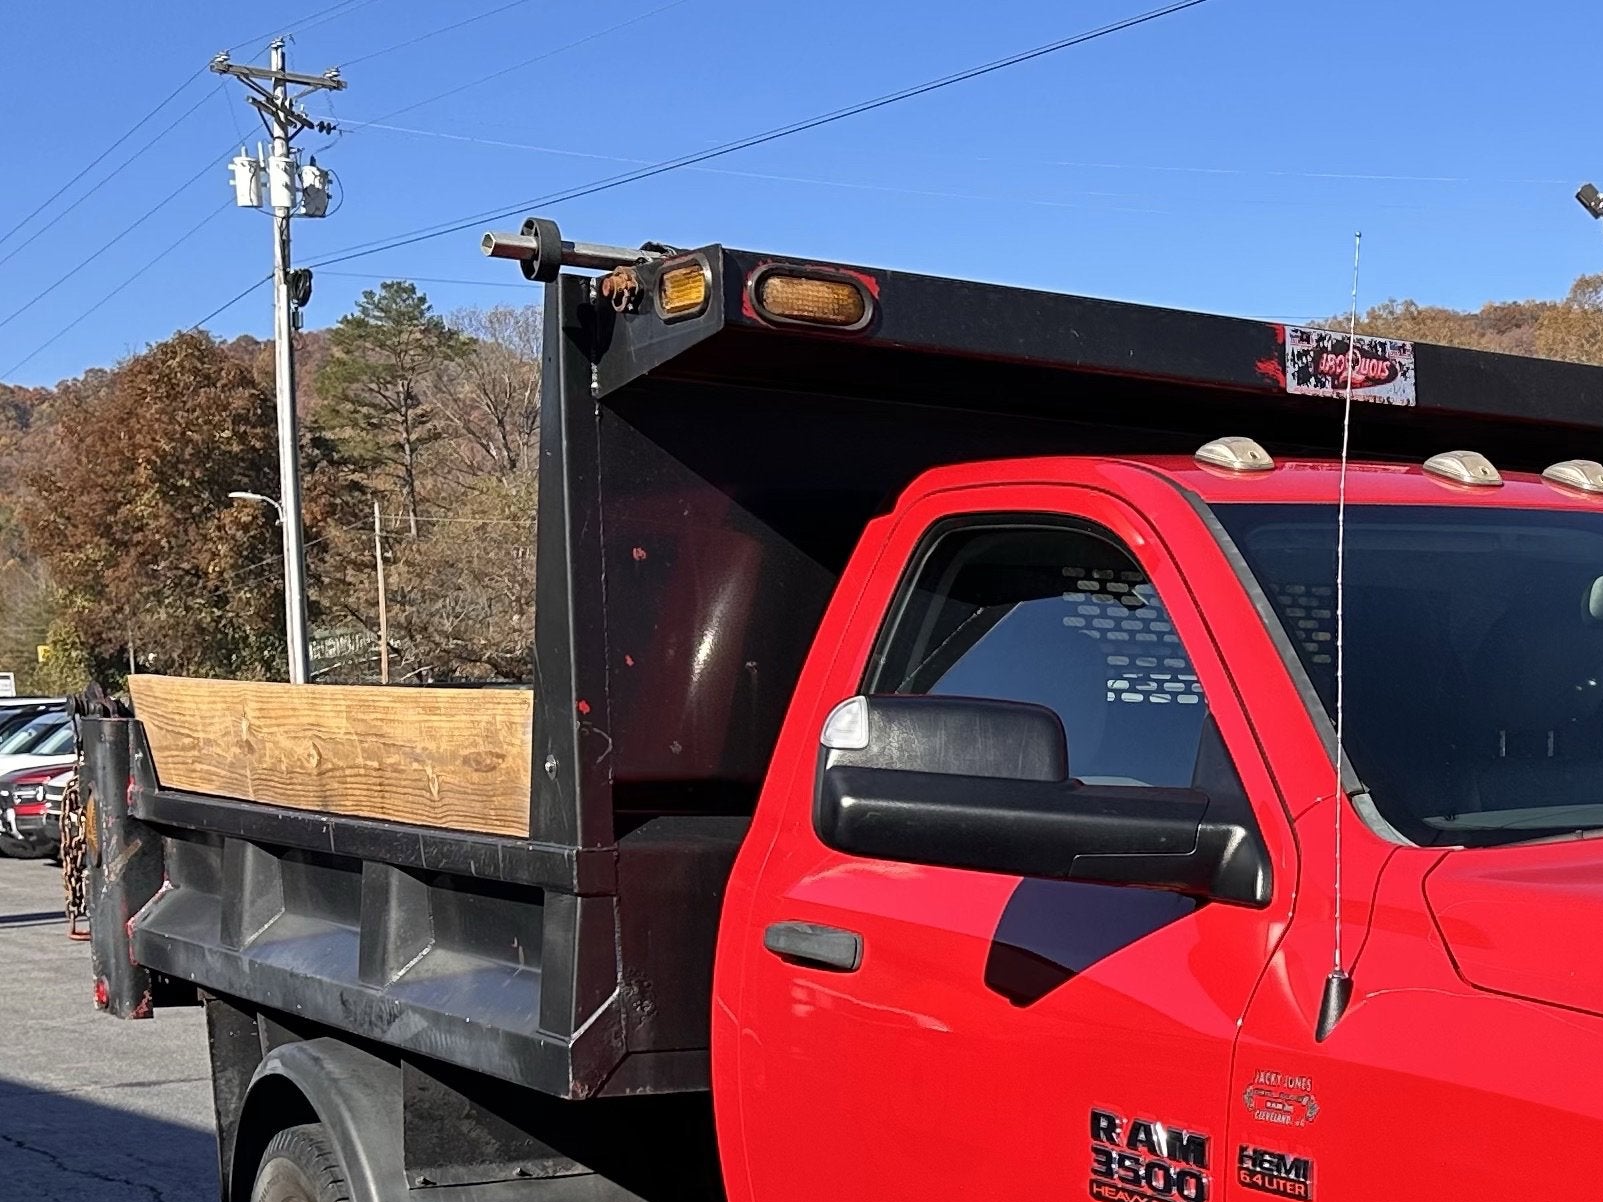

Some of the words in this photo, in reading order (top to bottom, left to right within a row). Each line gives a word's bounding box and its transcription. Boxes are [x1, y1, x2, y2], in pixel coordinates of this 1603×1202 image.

[1090, 1107, 1210, 1170] RAM
[1238, 1144, 1314, 1182] HEMI
[1265, 1175, 1306, 1197] LITER
